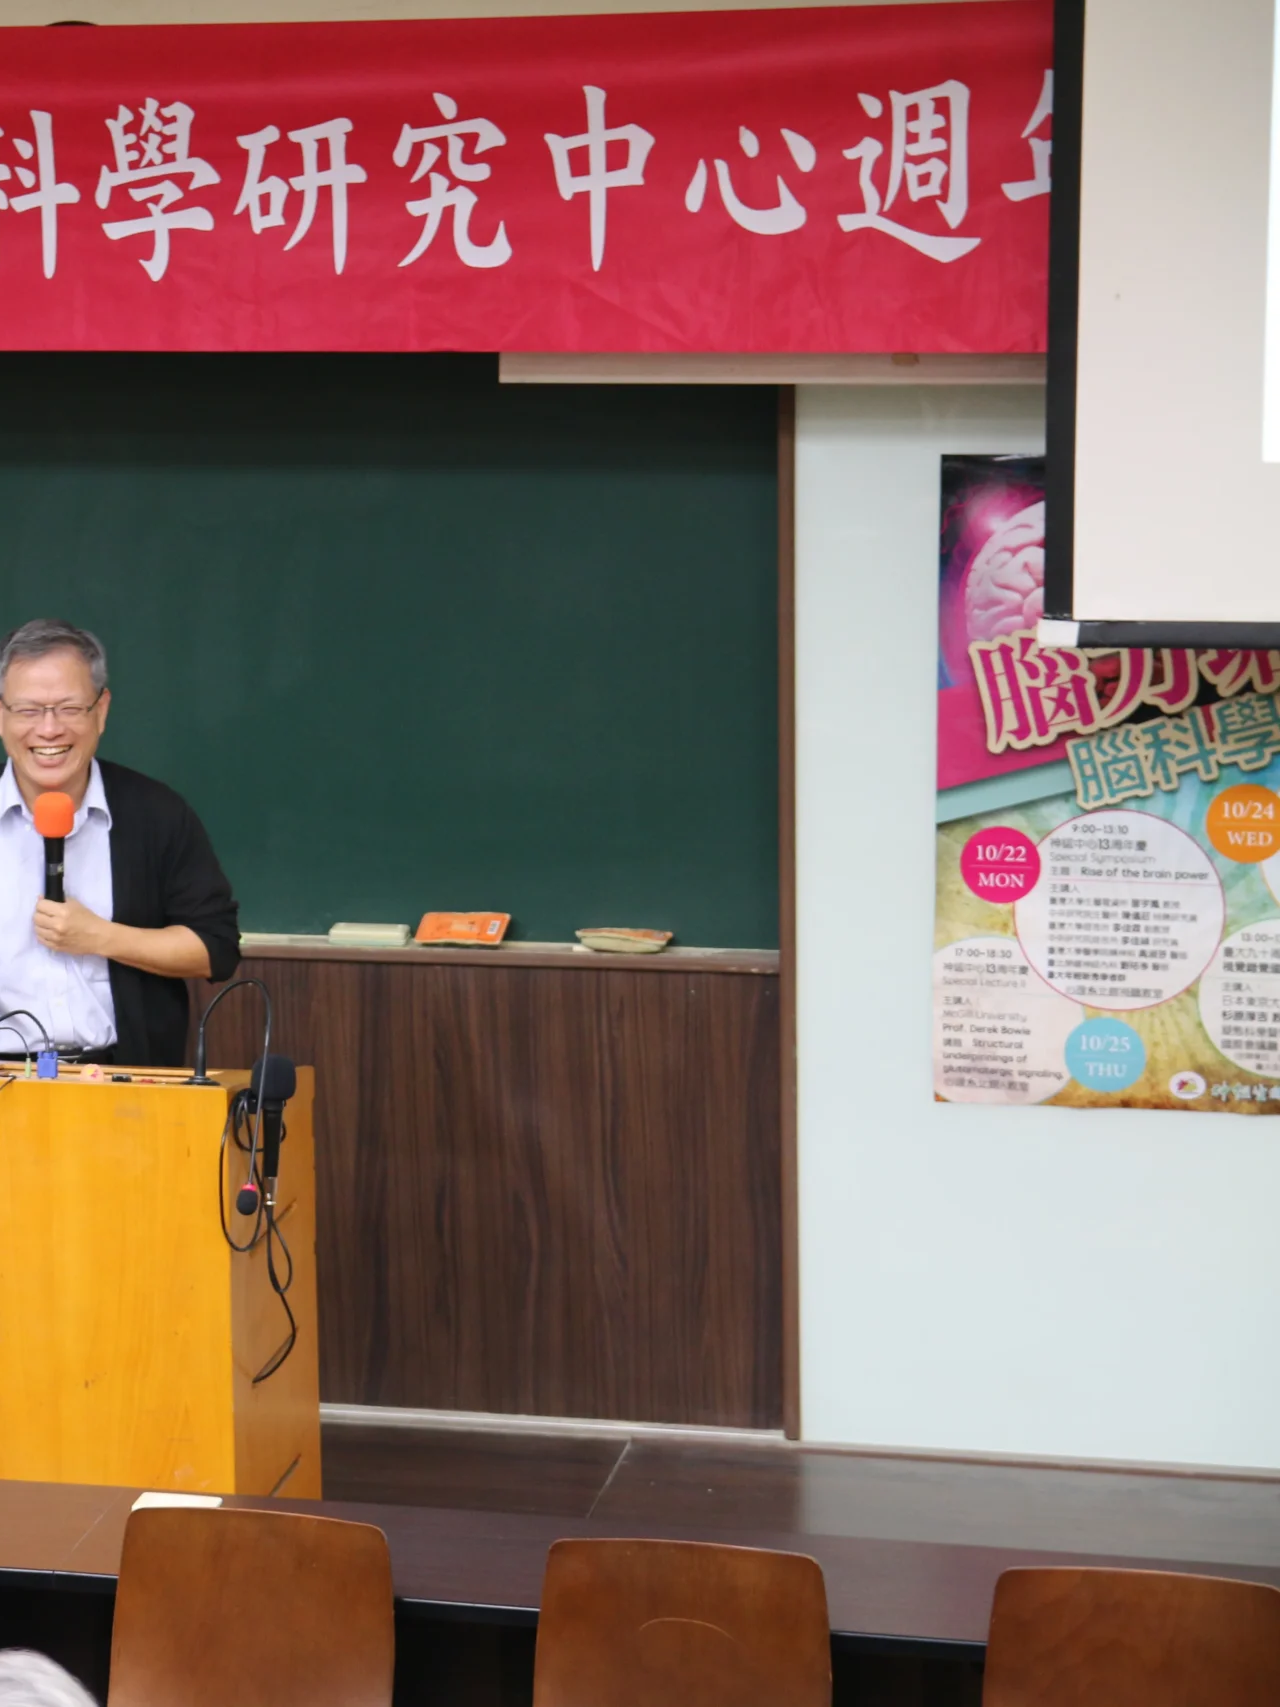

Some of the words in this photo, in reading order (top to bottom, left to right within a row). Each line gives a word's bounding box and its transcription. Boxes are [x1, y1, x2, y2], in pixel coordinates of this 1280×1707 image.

[975, 636, 1280, 745] 腦力
[1071, 696, 1280, 806] 腦科學
[1221, 800, 1275, 820] 10/24
[1225, 829, 1273, 847] WED
[975, 843, 1028, 863] 10/22
[1049, 852, 1087, 863] Special
[1090, 853, 1157, 865] Symposium
[977, 871, 1026, 889] MON
[1080, 866, 1103, 877] Rise
[1106, 867, 1119, 877] of
[1121, 867, 1140, 878] the
[1143, 869, 1172, 879] brain
[1174, 871, 1210, 881] power
[969, 1024, 998, 1034] Derek
[1000, 1025, 1032, 1036] Bowie
[972, 1038, 1024, 1049] Structural
[1078, 1033, 1132, 1053] 10/25
[1016, 1054, 1028, 1063] of
[1084, 1060, 1128, 1078] THU
